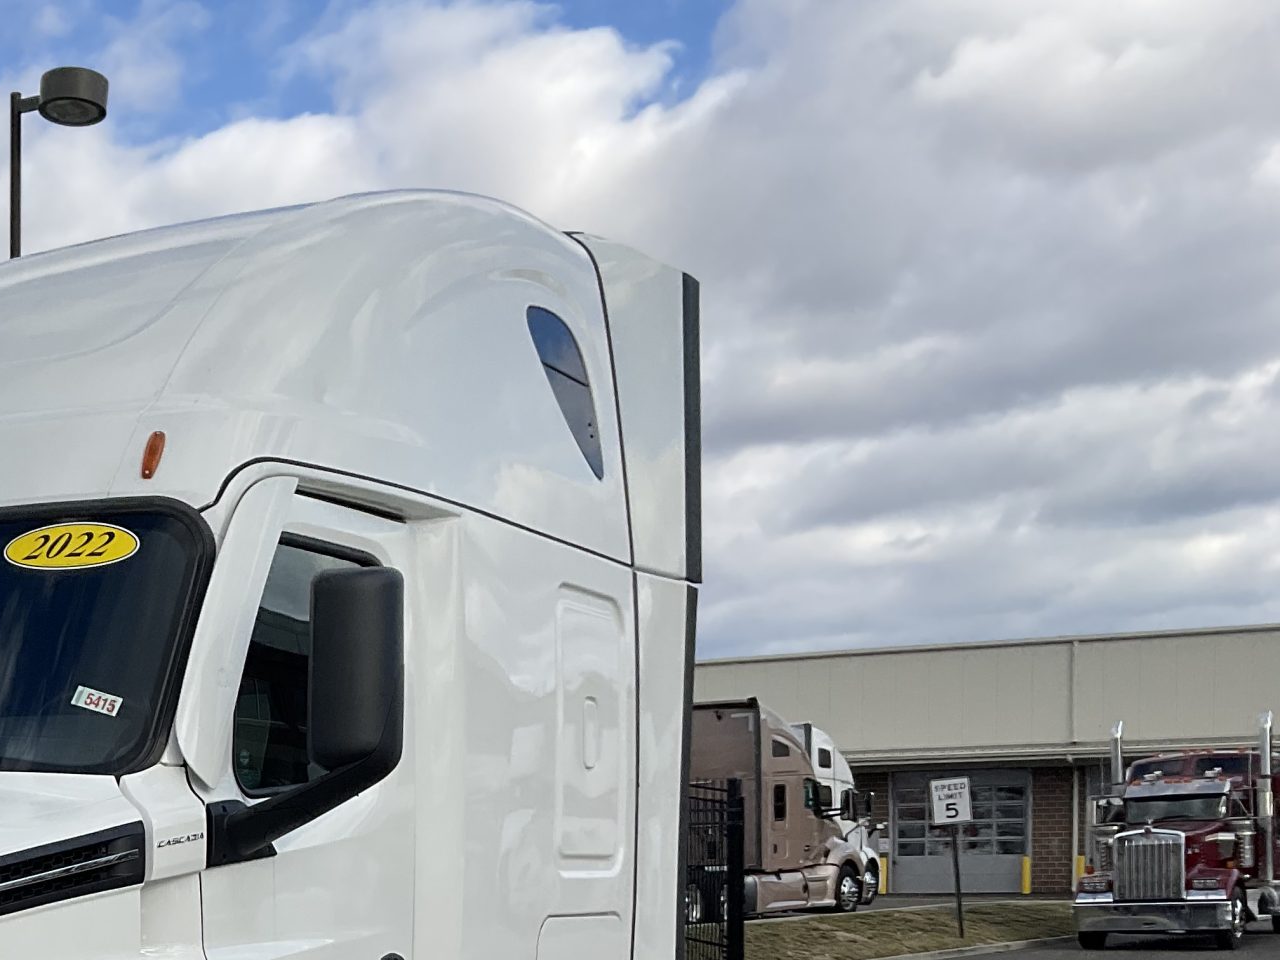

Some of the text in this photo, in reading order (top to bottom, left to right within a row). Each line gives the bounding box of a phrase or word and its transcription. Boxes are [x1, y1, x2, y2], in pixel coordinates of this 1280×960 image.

[21, 531, 116, 560] 2022
[84, 692, 117, 713] 5415
[934, 783, 966, 793] SPEED
[938, 791, 962, 801] LIMIT
[945, 803, 959, 819] 5
[156, 831, 204, 848] CASCADIA
